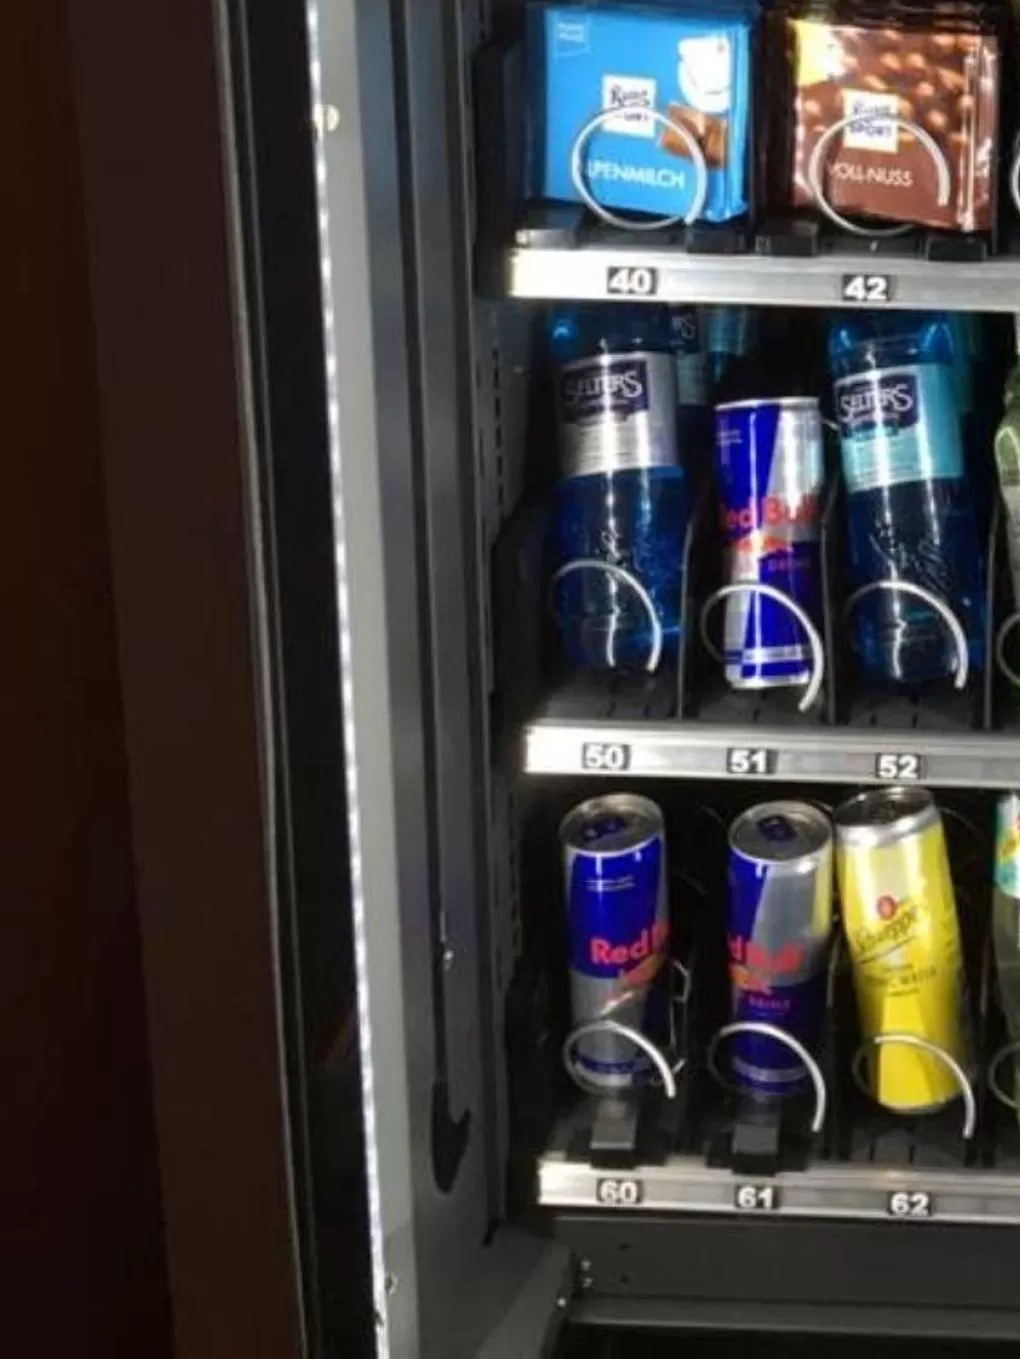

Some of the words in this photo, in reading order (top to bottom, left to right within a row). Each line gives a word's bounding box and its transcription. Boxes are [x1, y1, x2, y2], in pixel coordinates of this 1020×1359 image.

[588, 159, 685, 189] LPENMILCH
[609, 270, 651, 293] 40
[844, 277, 887, 301] 42
[584, 744, 625, 768] 50
[732, 750, 767, 773] 51
[880, 754, 917, 778] 52
[599, 1181, 638, 1204] 60
[738, 1188, 773, 1209] 61
[891, 1194, 929, 1216] 62
